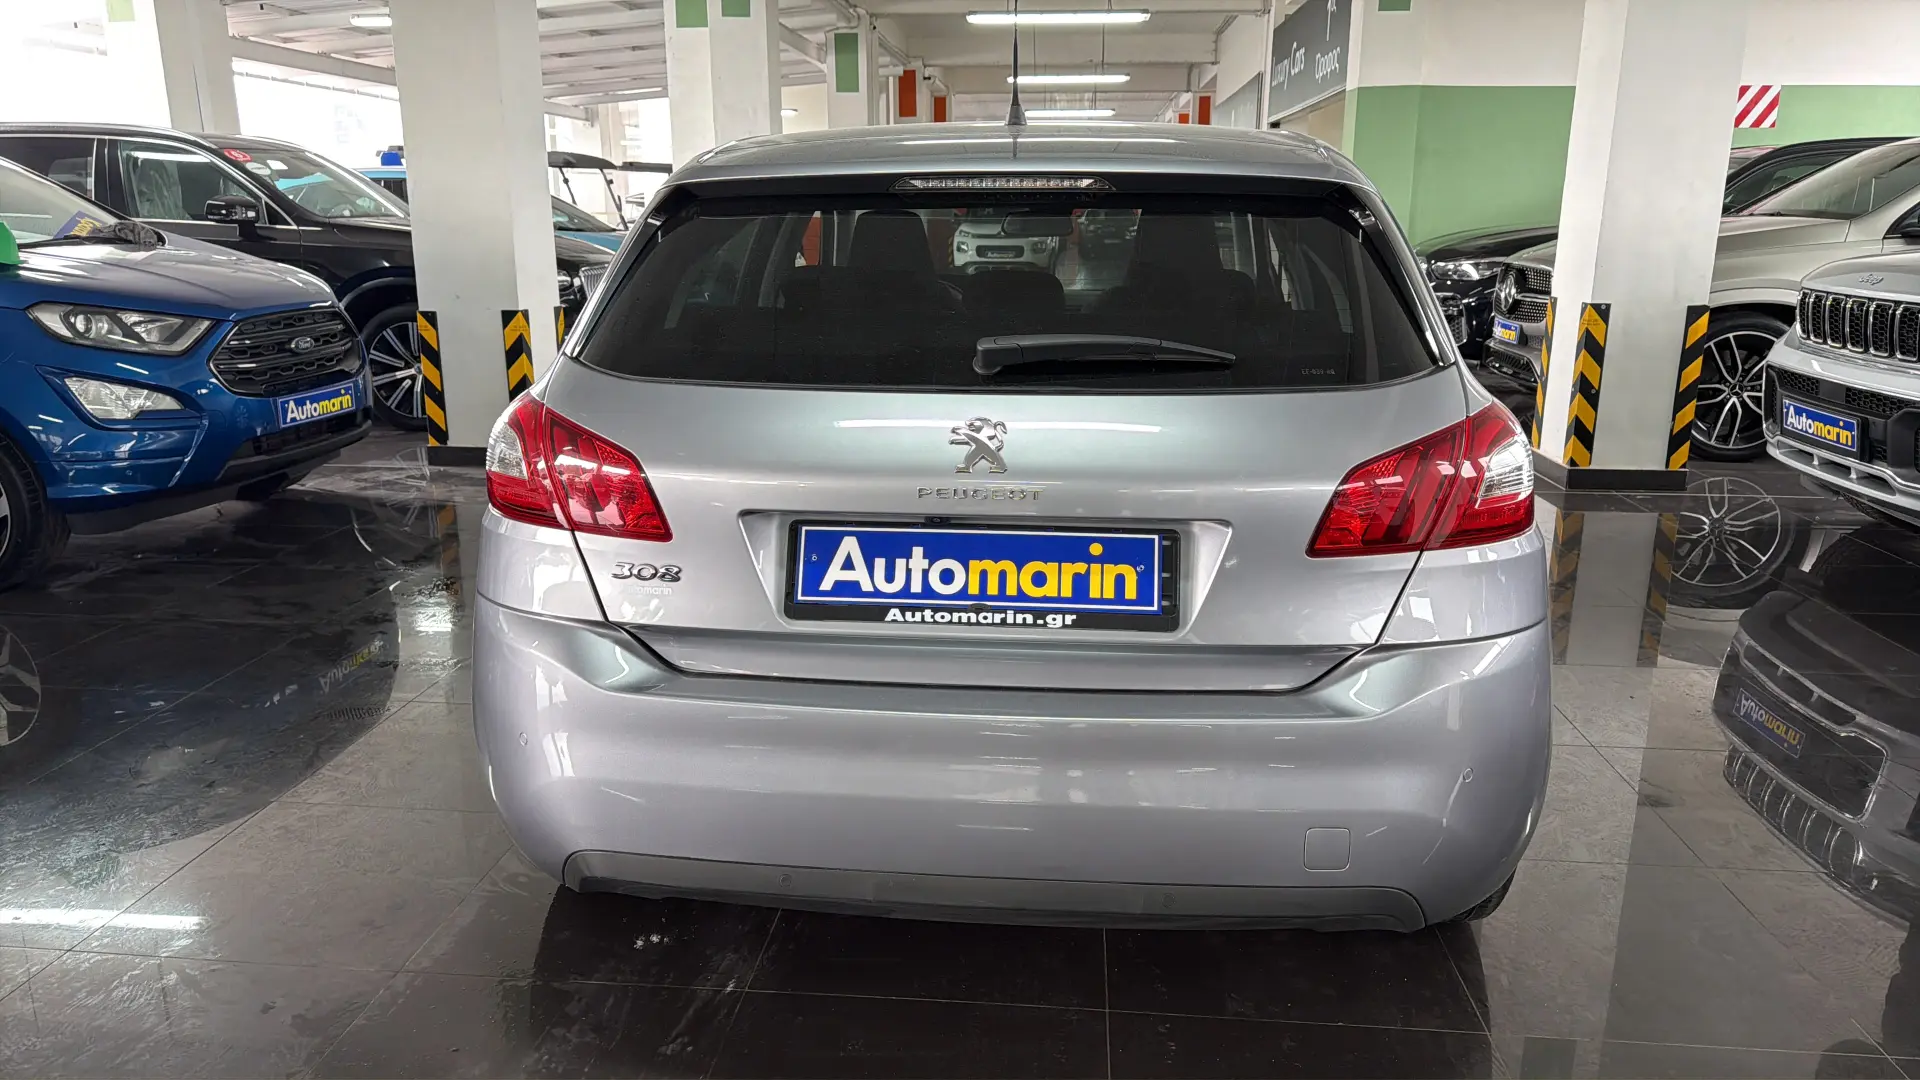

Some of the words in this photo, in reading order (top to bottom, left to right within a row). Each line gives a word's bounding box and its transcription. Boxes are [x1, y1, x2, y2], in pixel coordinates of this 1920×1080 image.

[1291, 41, 1305, 76] Cars
[286, 389, 352, 423] Automarin
[1787, 405, 1852, 446] Automarin
[917, 486, 1045, 501] PEUGEOT
[611, 562, 682, 583] 308
[819, 536, 1137, 600] Automarin
[884, 608, 1077, 628] Automarin.gr
